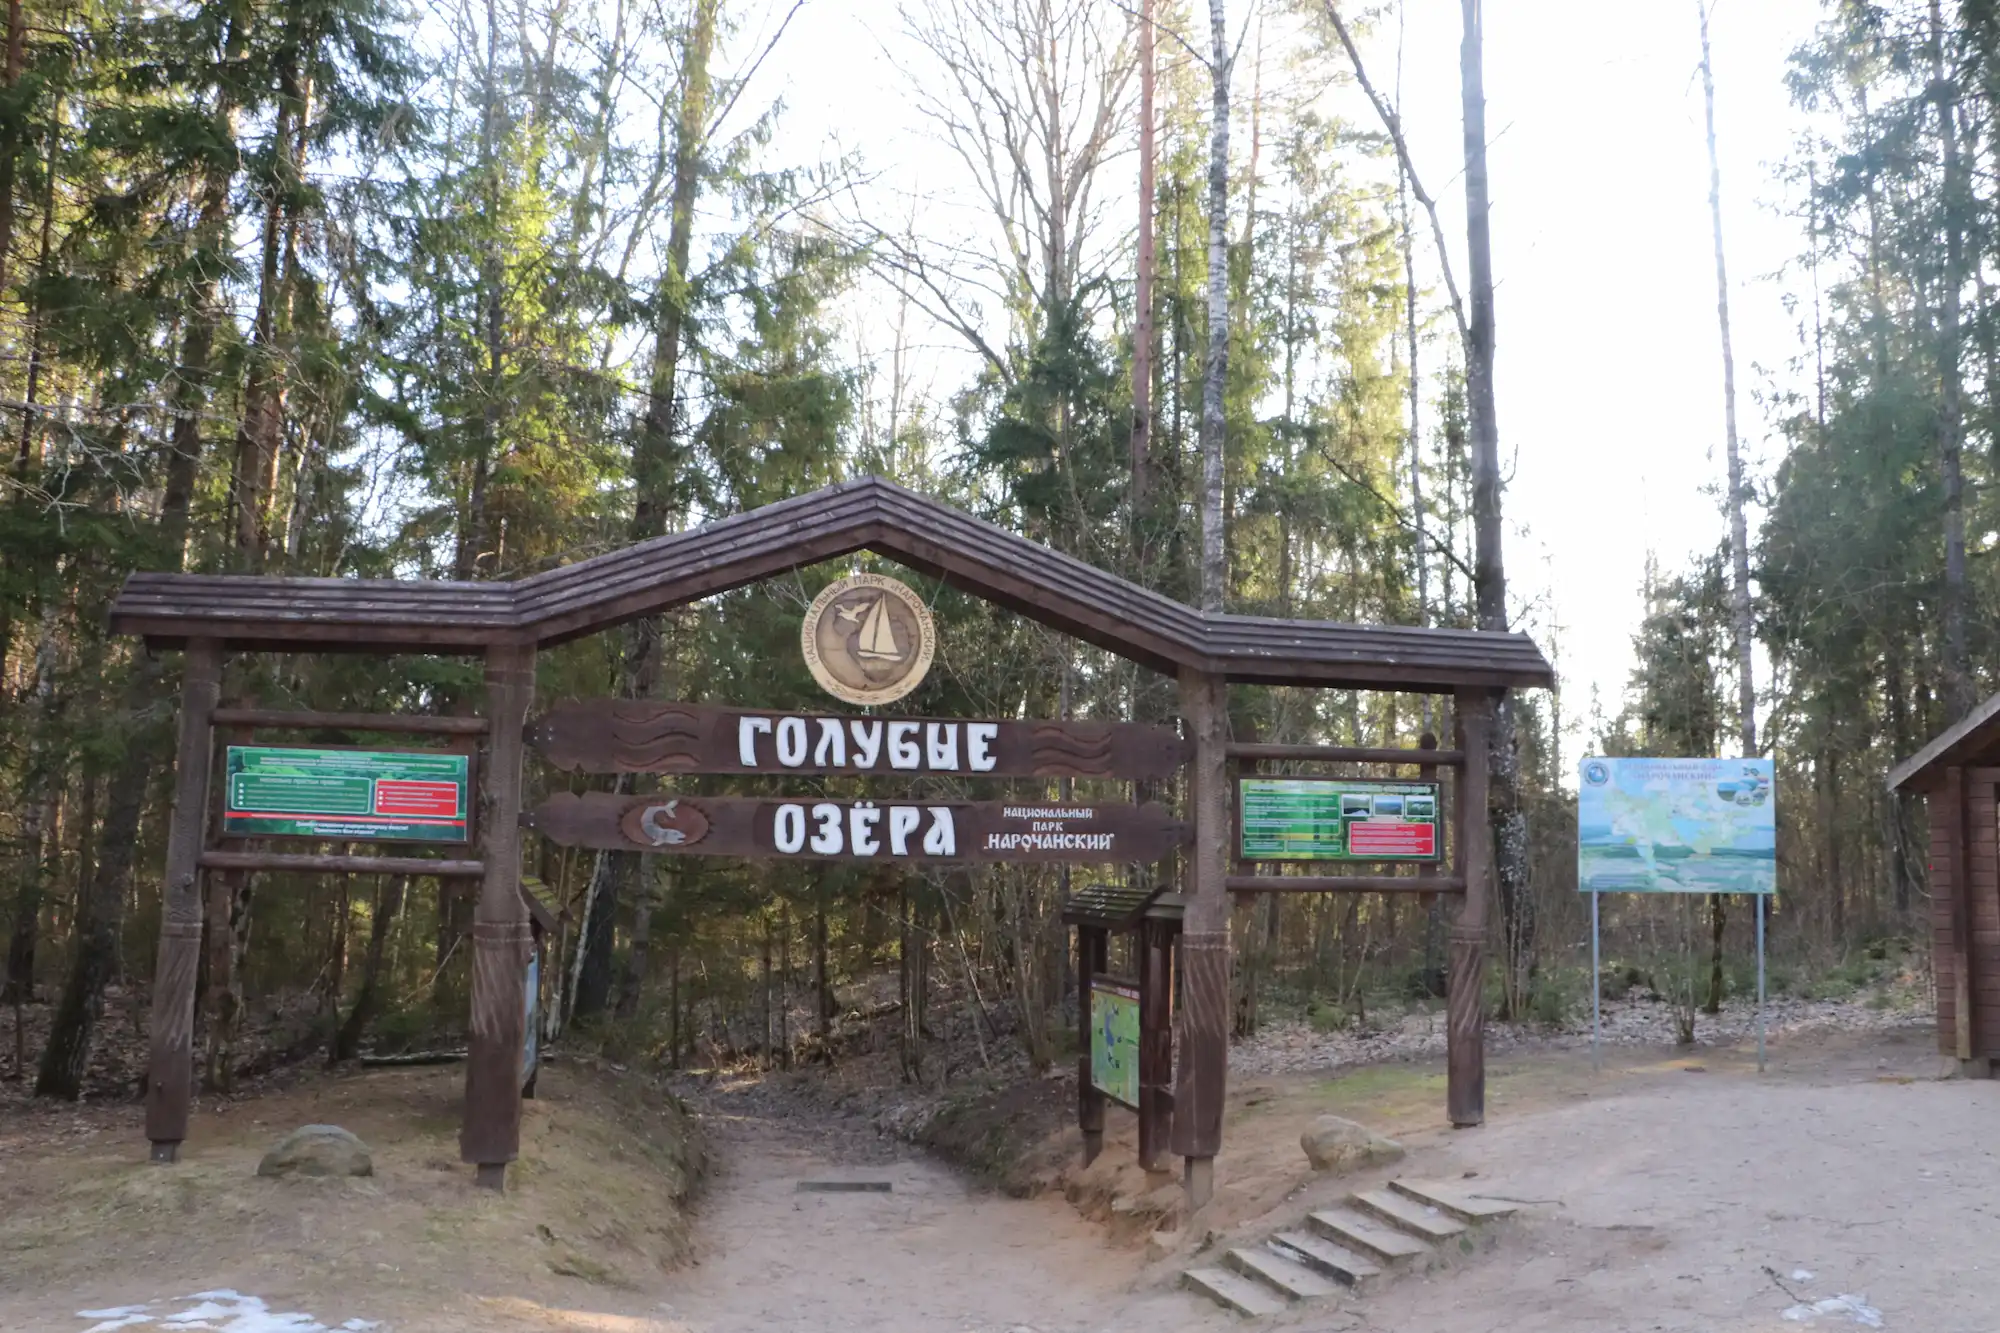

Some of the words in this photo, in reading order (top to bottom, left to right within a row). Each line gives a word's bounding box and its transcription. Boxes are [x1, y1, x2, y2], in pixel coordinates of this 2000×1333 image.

[803, 581, 849, 665] НАЦИОНАЛЬНЫЙ
[853, 576, 886, 586] ПАРК
[739, 716, 998, 772] ГОЛУБЫЕ
[774, 801, 956, 856] ОЗЁРА
[1003, 806, 1093, 820] НАЦИОНАЛЬНЫЙ
[1032, 821, 1064, 832] ПАРК
